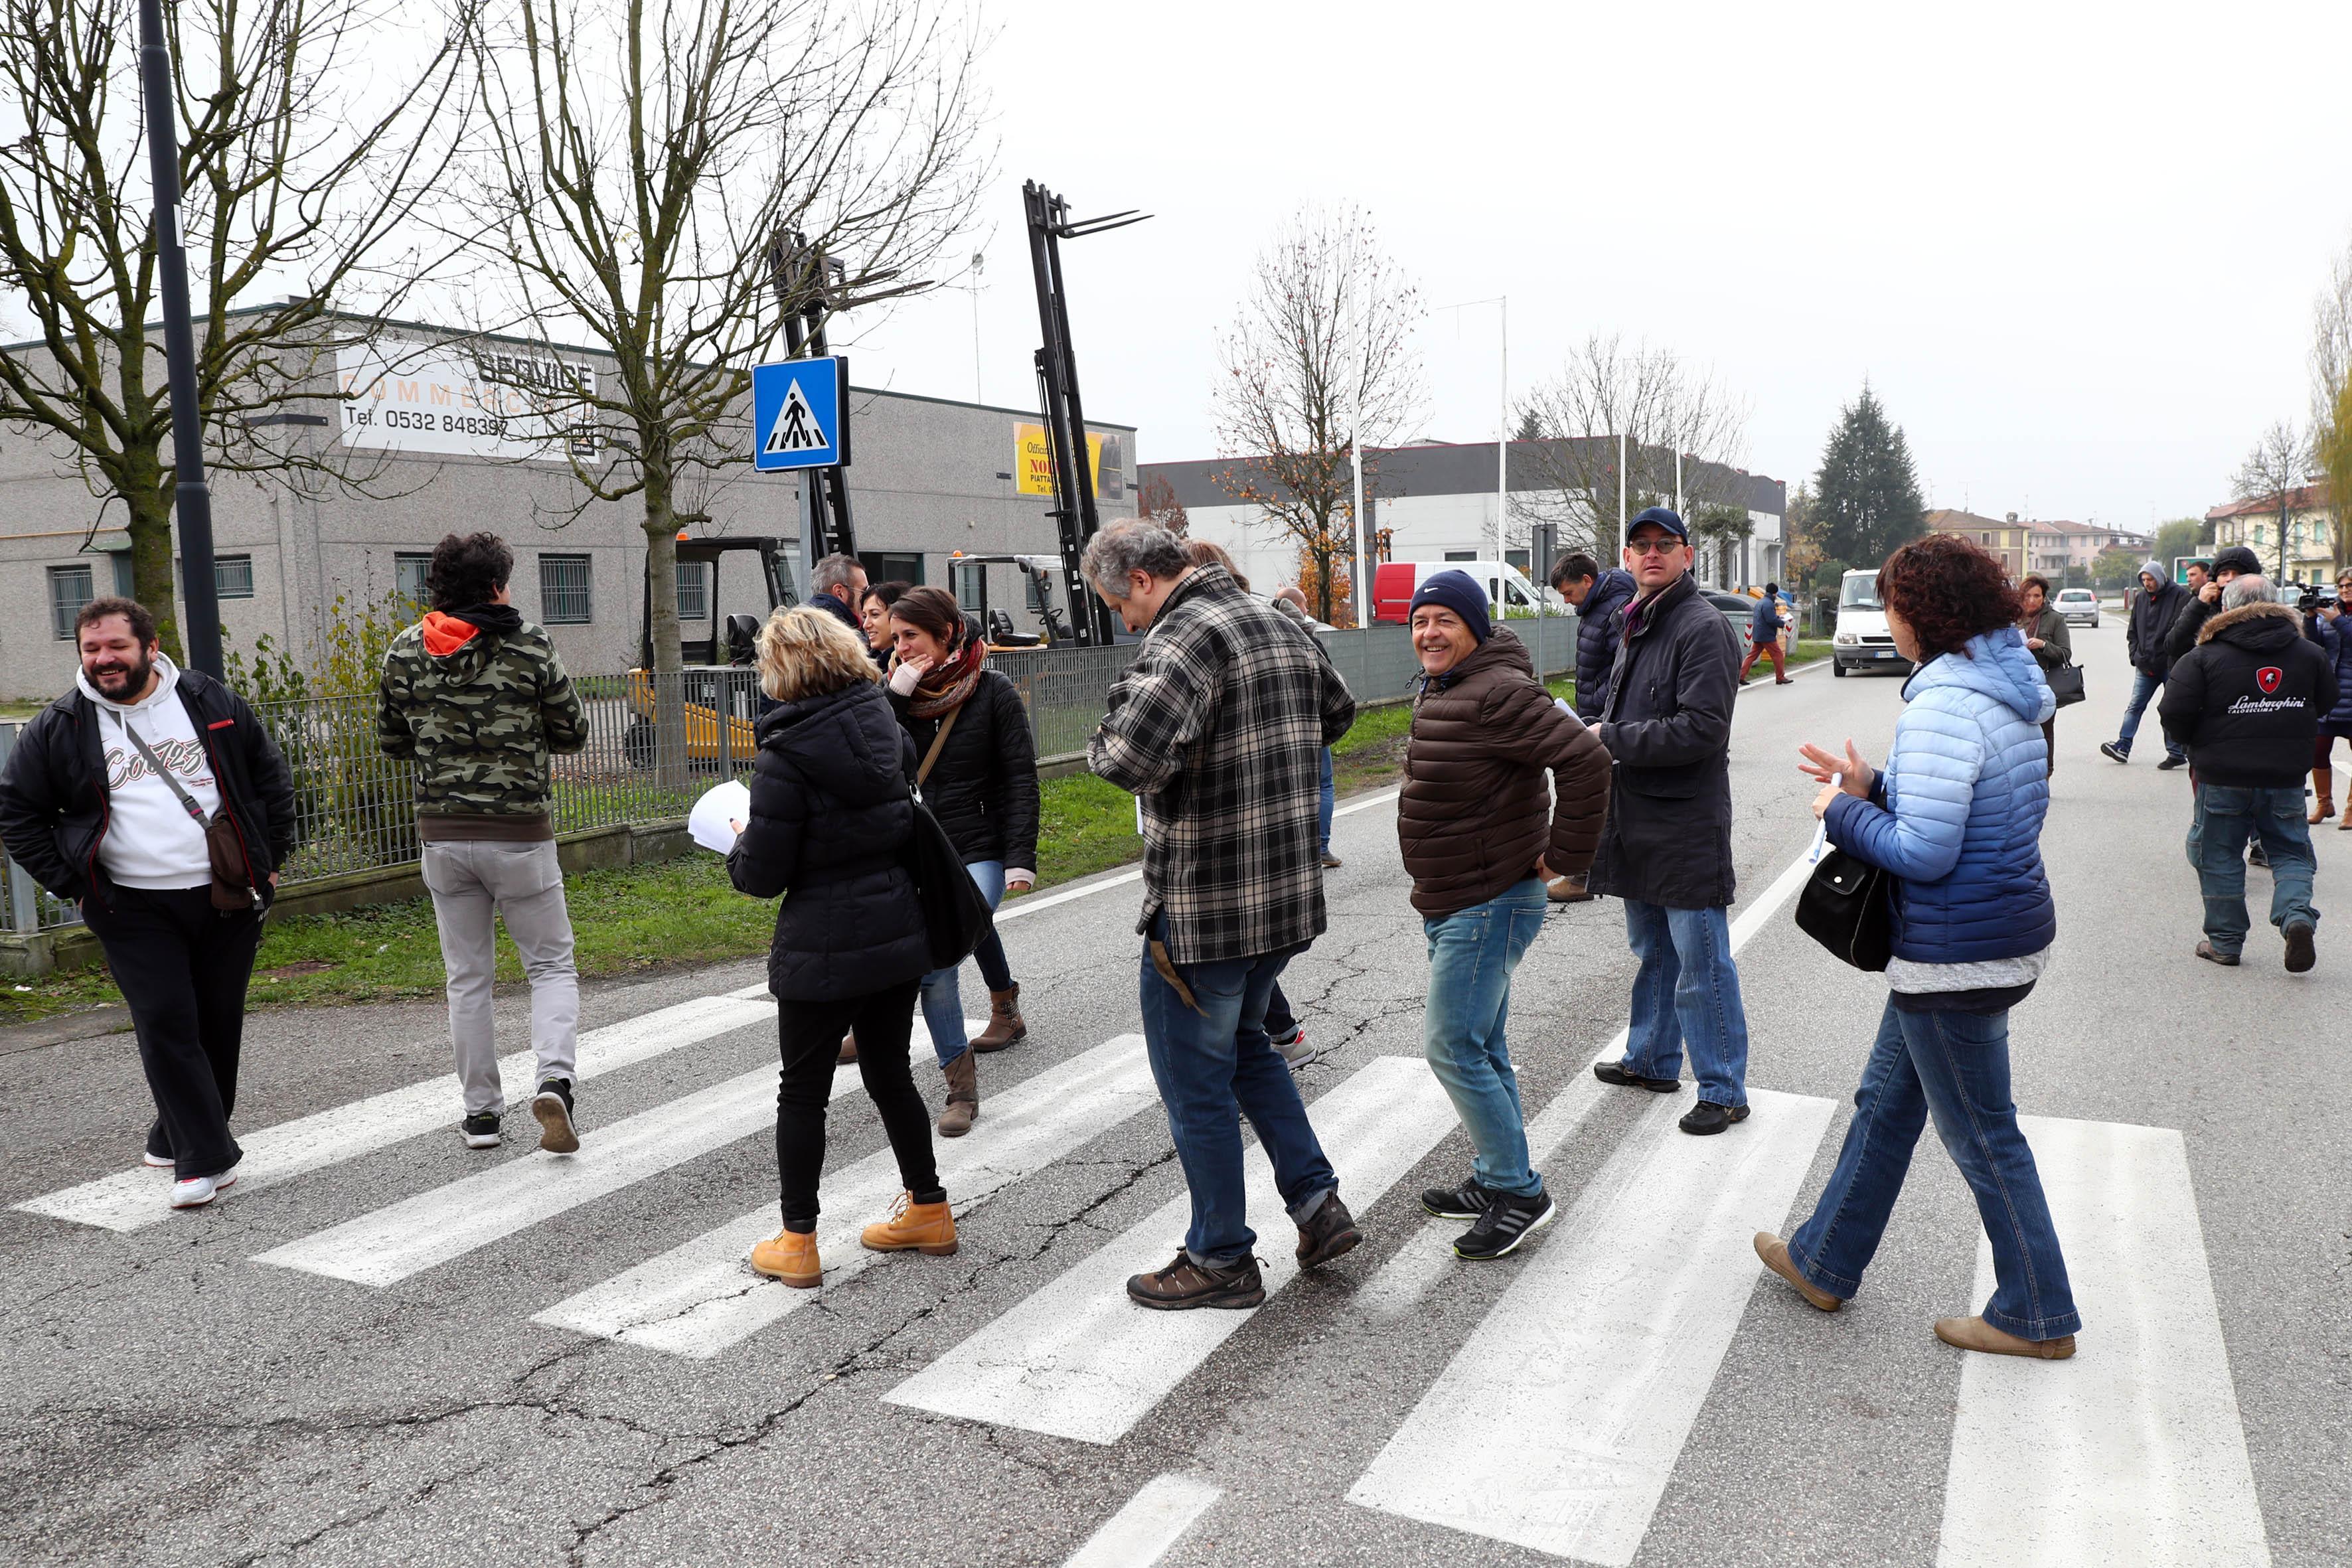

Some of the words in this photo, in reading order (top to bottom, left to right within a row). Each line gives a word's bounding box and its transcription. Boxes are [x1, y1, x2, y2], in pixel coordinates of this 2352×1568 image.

[479, 354, 593, 394] SERVICE
[345, 406, 377, 426] Tel.
[386, 410, 435, 431] 0532
[443, 414, 509, 436] 848397
[1030, 474, 1052, 483] PIATTA
[2228, 695, 2306, 711] Lamborghini
